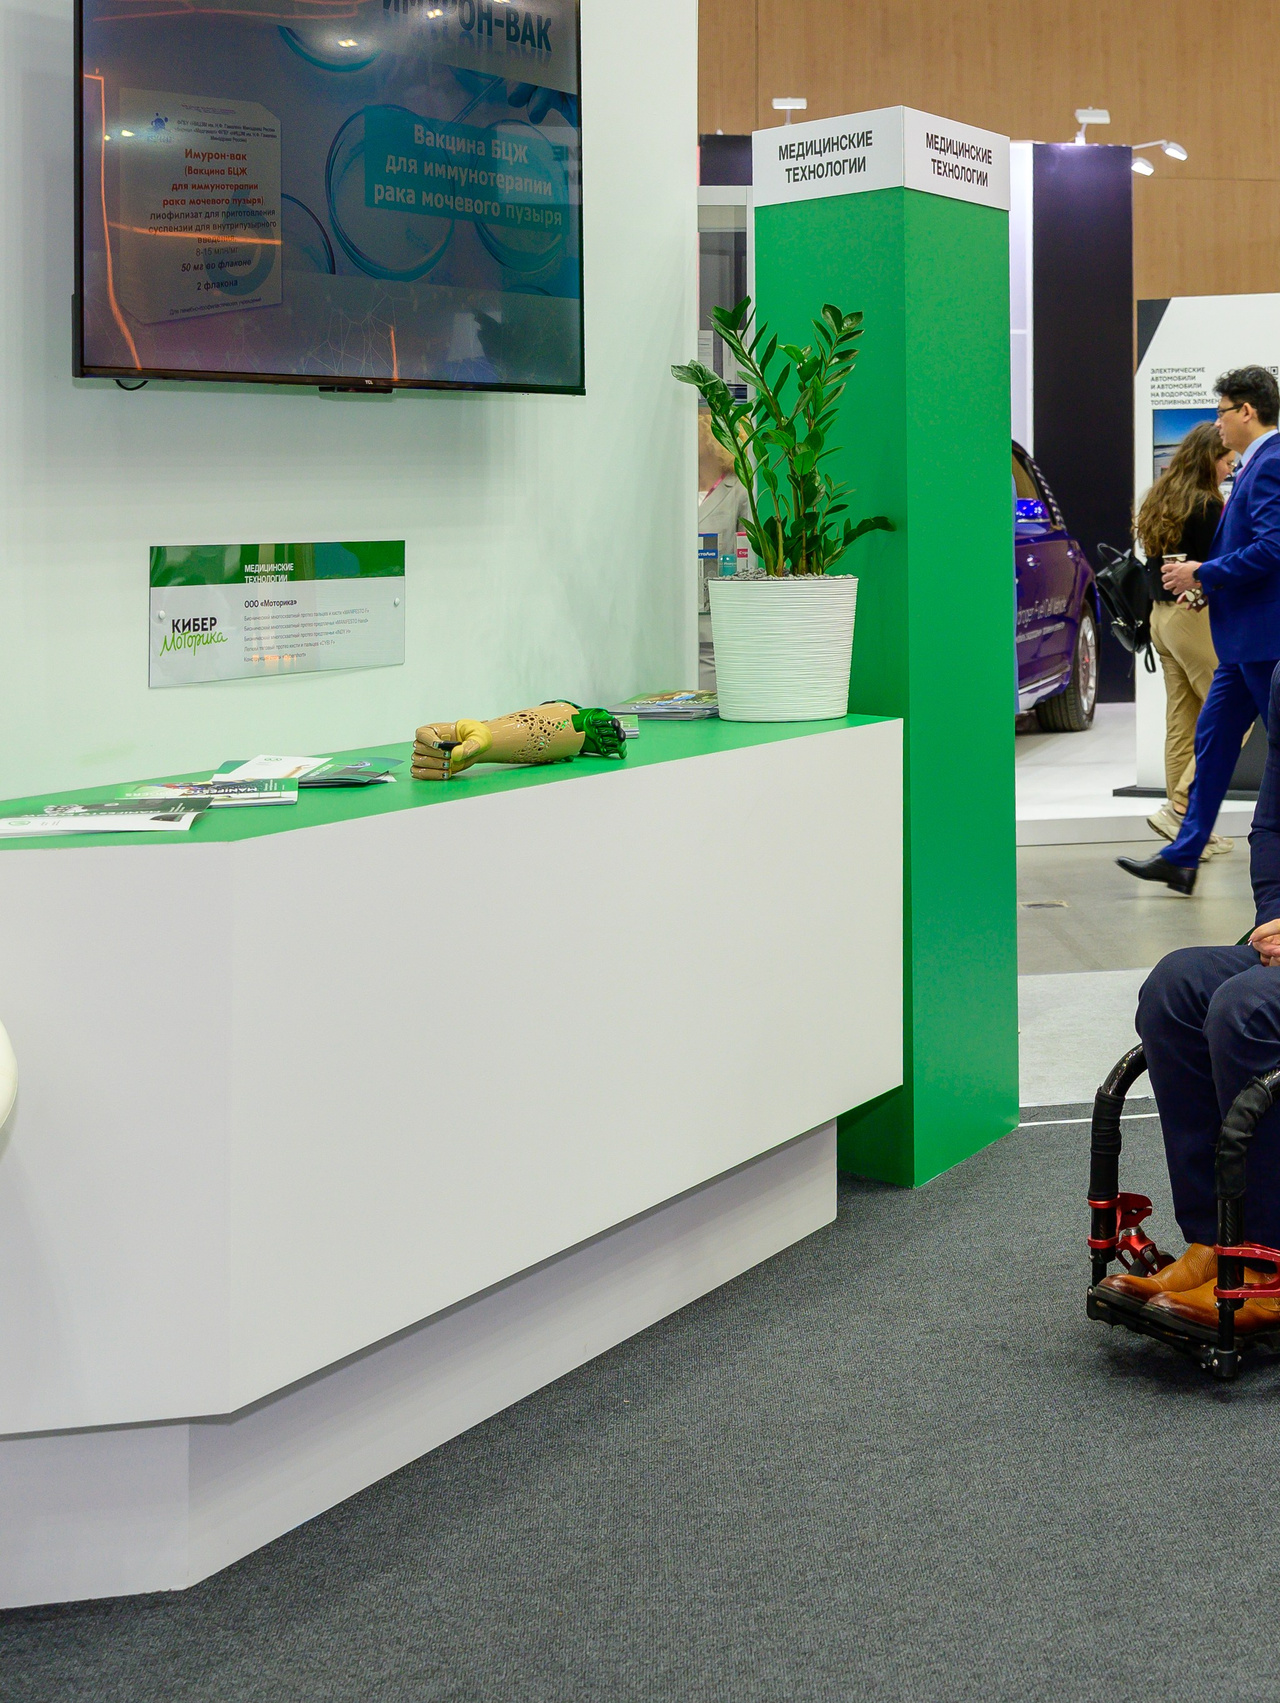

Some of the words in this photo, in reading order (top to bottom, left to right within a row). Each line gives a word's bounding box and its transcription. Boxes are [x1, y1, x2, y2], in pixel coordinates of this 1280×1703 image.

[414, 124, 486, 156] Вакцина
[491, 140, 529, 164] БЦЖ
[778, 130, 873, 161] МЕДИЦИНСКИЕ
[925, 132, 992, 166] МЕДИЦИНСКИЕ
[184, 149, 247, 163] Имурон-вак
[184, 166, 225, 177] (Вакцина
[227, 167, 248, 177] БЦЖ
[385, 154, 418, 174] для
[423, 162, 552, 196] иммунотерапии
[785, 156, 867, 184] ТЕХНОЛОГИИ
[931, 158, 989, 187] ТЕХНОЛОГИИ
[171, 183, 188, 192] для
[191, 182, 259, 192] иммунотерапии
[162, 198, 186, 208] рака
[189, 197, 230, 206] мочевого
[374, 183, 416, 205] рака
[421, 192, 501, 217] мочевого
[505, 203, 563, 228] пузыря
[150, 210, 203, 220] лиофилизат
[204, 211, 219, 219] для
[221, 208, 276, 219] приготовления
[195, 222, 210, 232] для
[212, 220, 277, 232] внутрипузырного
[181, 263, 191, 272] 50
[197, 282, 202, 291] 2
[204, 279, 239, 291] флакона
[244, 562, 294, 573] МЕДИЦИНСКИЕ
[244, 574, 288, 583] ТЕХНОЛОГИИ
[244, 600, 258, 609] ООО
[259, 598, 297, 609] «Моторика»
[171, 617, 218, 634] КИБЕР
[159, 630, 229, 657] Моторика
